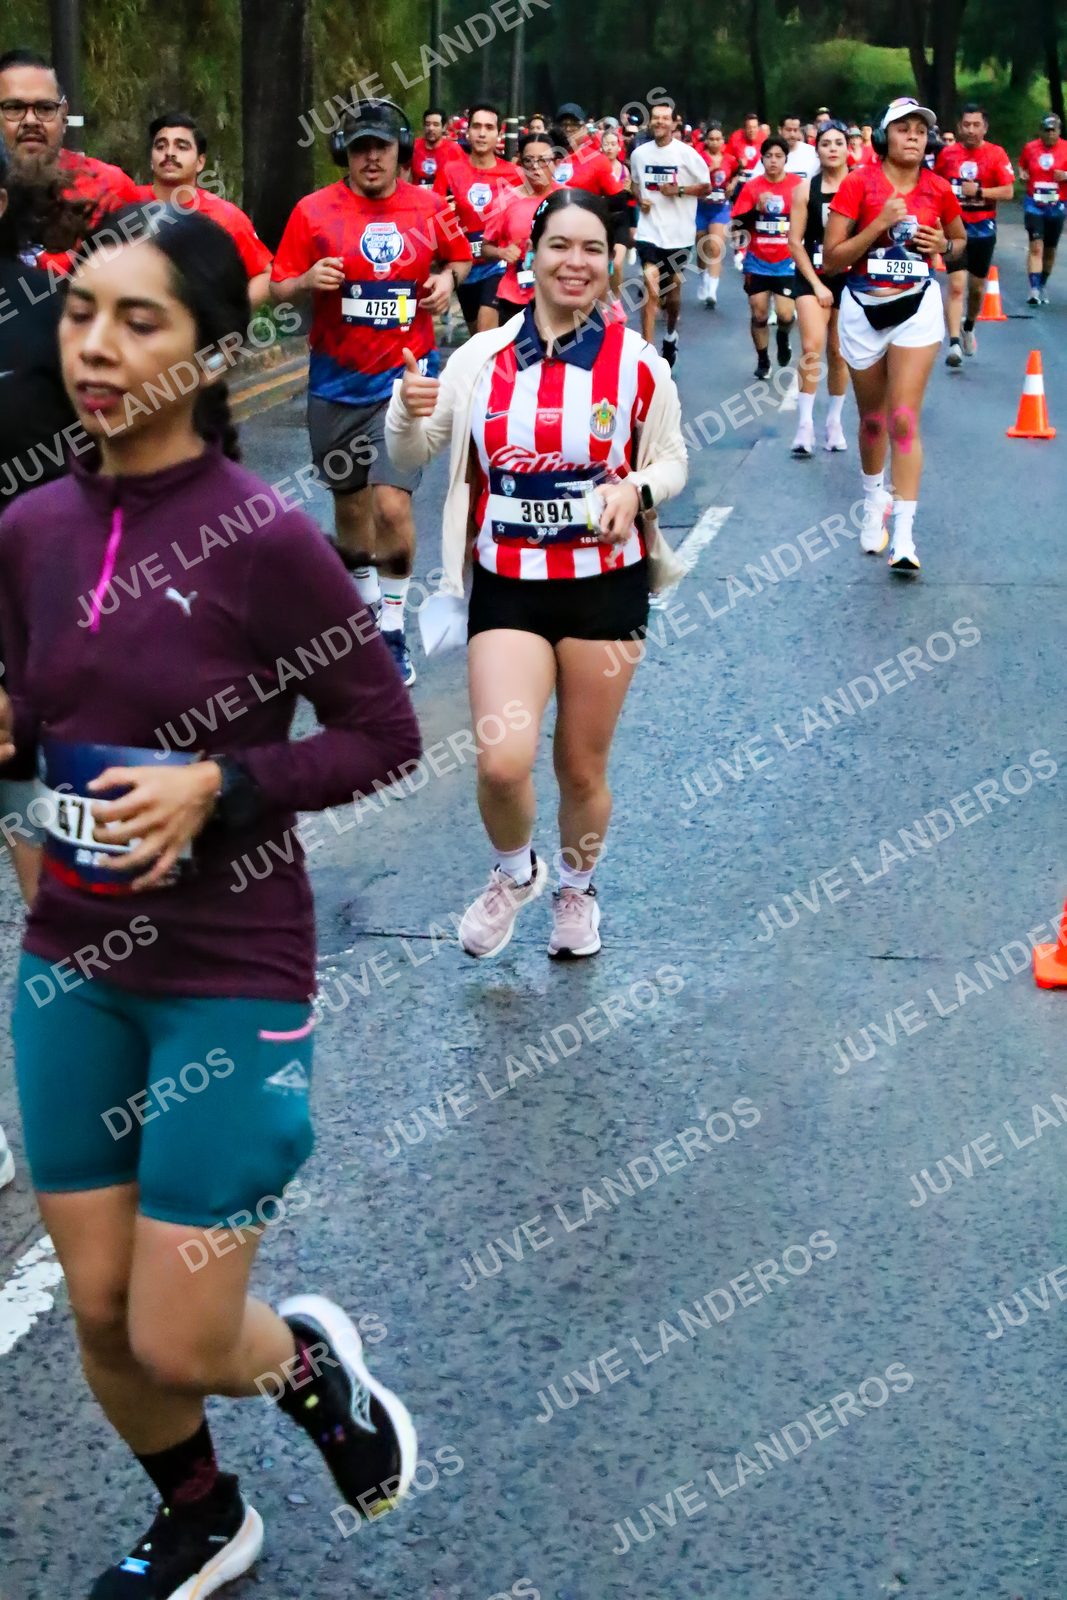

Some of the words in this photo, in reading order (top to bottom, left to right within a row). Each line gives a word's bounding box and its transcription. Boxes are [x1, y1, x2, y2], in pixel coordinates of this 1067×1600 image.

[886, 261, 913, 274] 5299
[366, 301, 397, 316] 4752
[521, 501, 574, 523] 3894
